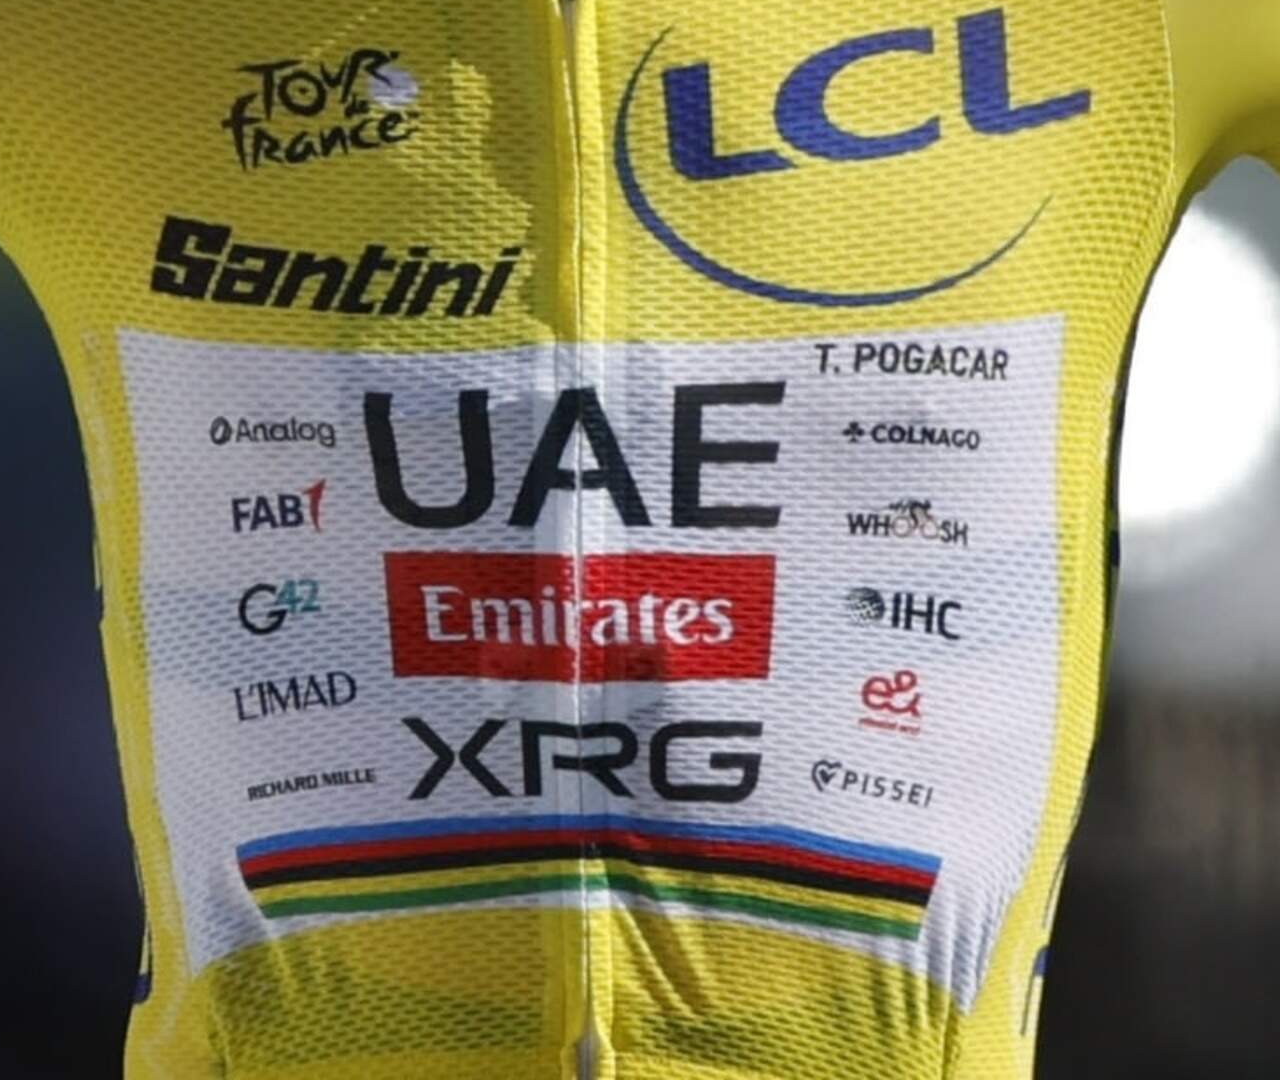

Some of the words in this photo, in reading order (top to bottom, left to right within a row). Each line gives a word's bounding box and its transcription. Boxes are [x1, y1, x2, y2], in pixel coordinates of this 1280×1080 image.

[661, 7, 1091, 181] LCL
[150, 215, 522, 318] Santini
[814, 344, 841, 373] T.
[853, 342, 1009, 380] POGACAR
[235, 416, 335, 448] Analog
[364, 381, 786, 529] UAE
[870, 424, 980, 451] COLNAGO
[238, 579, 320, 635] G42
[420, 584, 735, 649] Emirates
[891, 592, 962, 640] IHC
[234, 671, 357, 720] L'IMAD
[248, 773, 318, 801] RICHARD
[322, 768, 376, 787] MILLE
[401, 717, 762, 804] XRG
[841, 770, 934, 808] PISSEI
